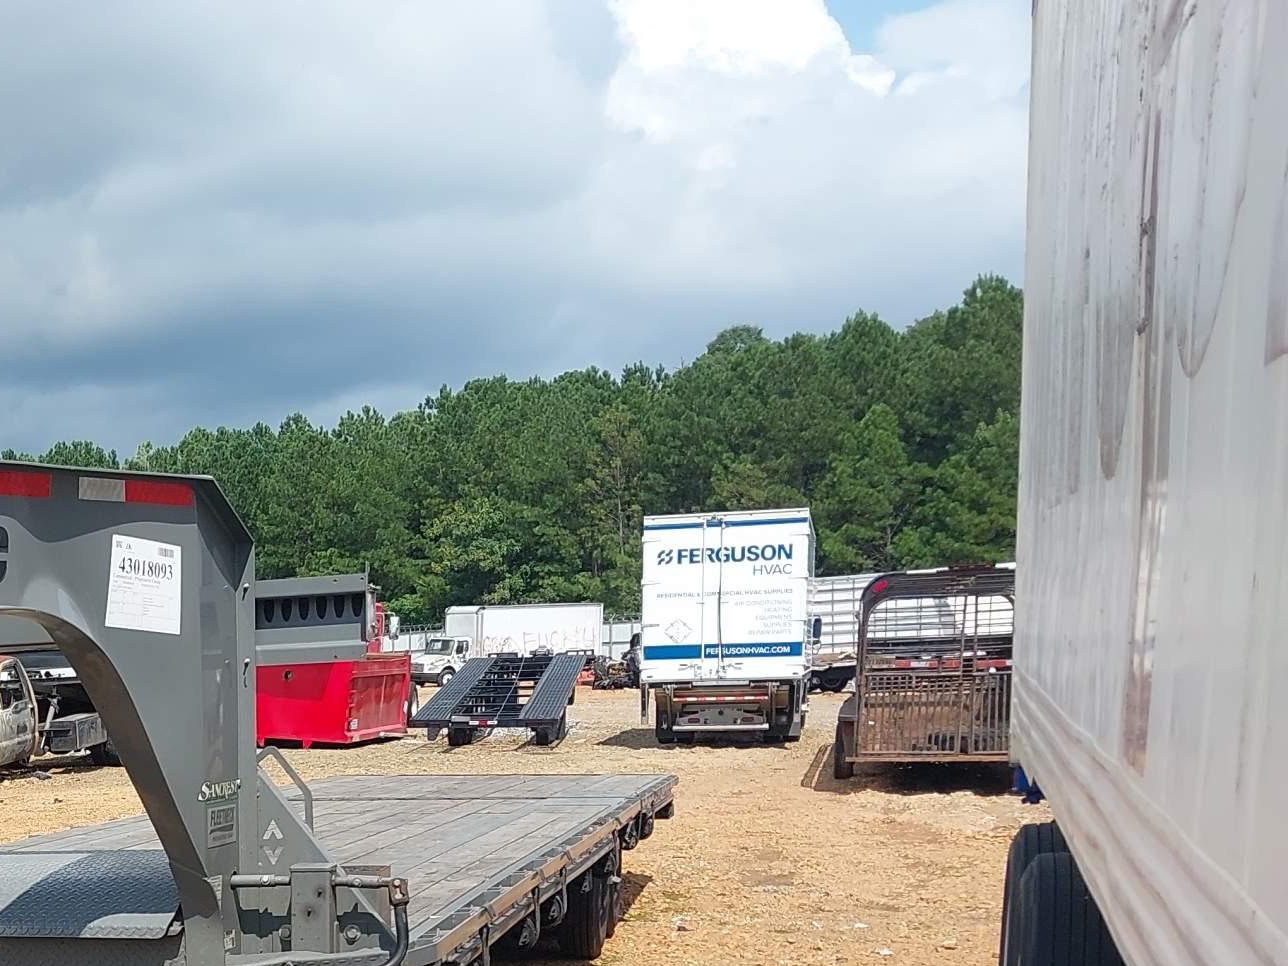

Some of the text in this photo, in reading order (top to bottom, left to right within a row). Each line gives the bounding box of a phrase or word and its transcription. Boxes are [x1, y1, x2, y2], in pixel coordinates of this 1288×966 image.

[677, 544, 793, 564] FERGUSON
[118, 556, 173, 580] 43018093
[753, 563, 793, 576] HVAC
